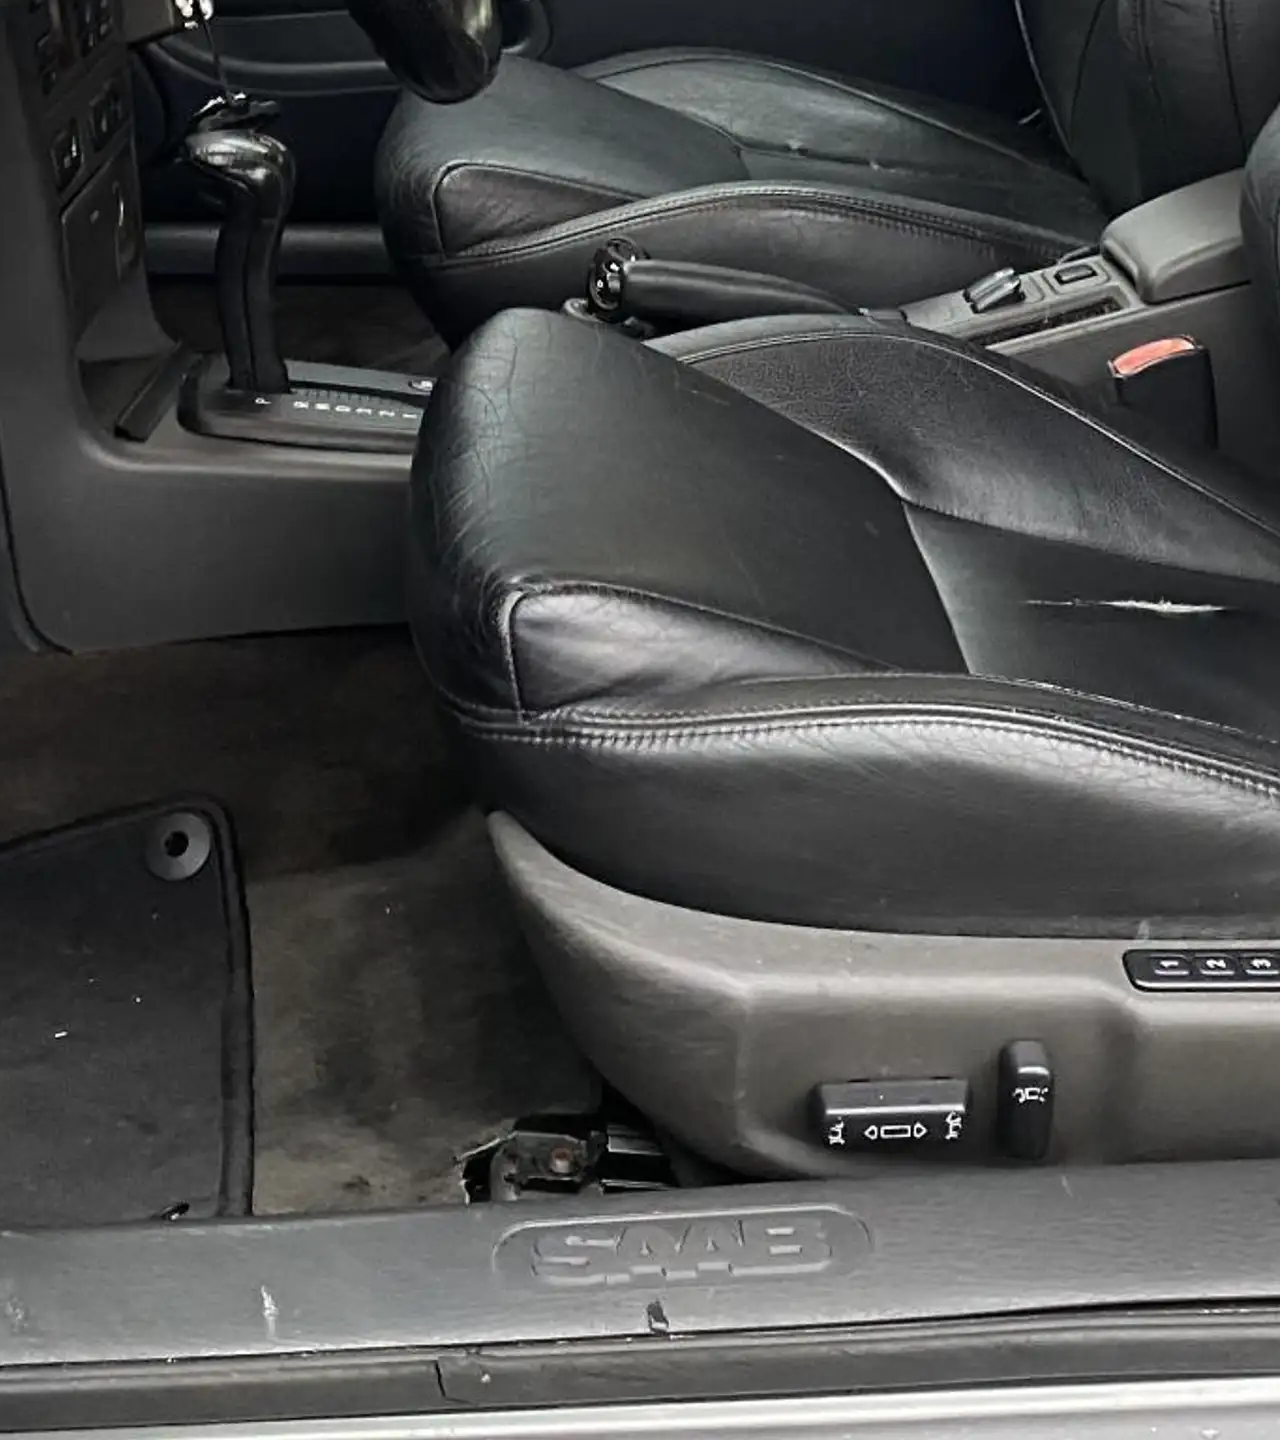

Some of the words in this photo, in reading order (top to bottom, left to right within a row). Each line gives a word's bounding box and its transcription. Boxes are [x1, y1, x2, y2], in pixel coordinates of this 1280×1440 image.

[1206, 959, 1226, 969] 2
[1252, 958, 1271, 969] 3
[532, 1218, 832, 1286] SAAB
